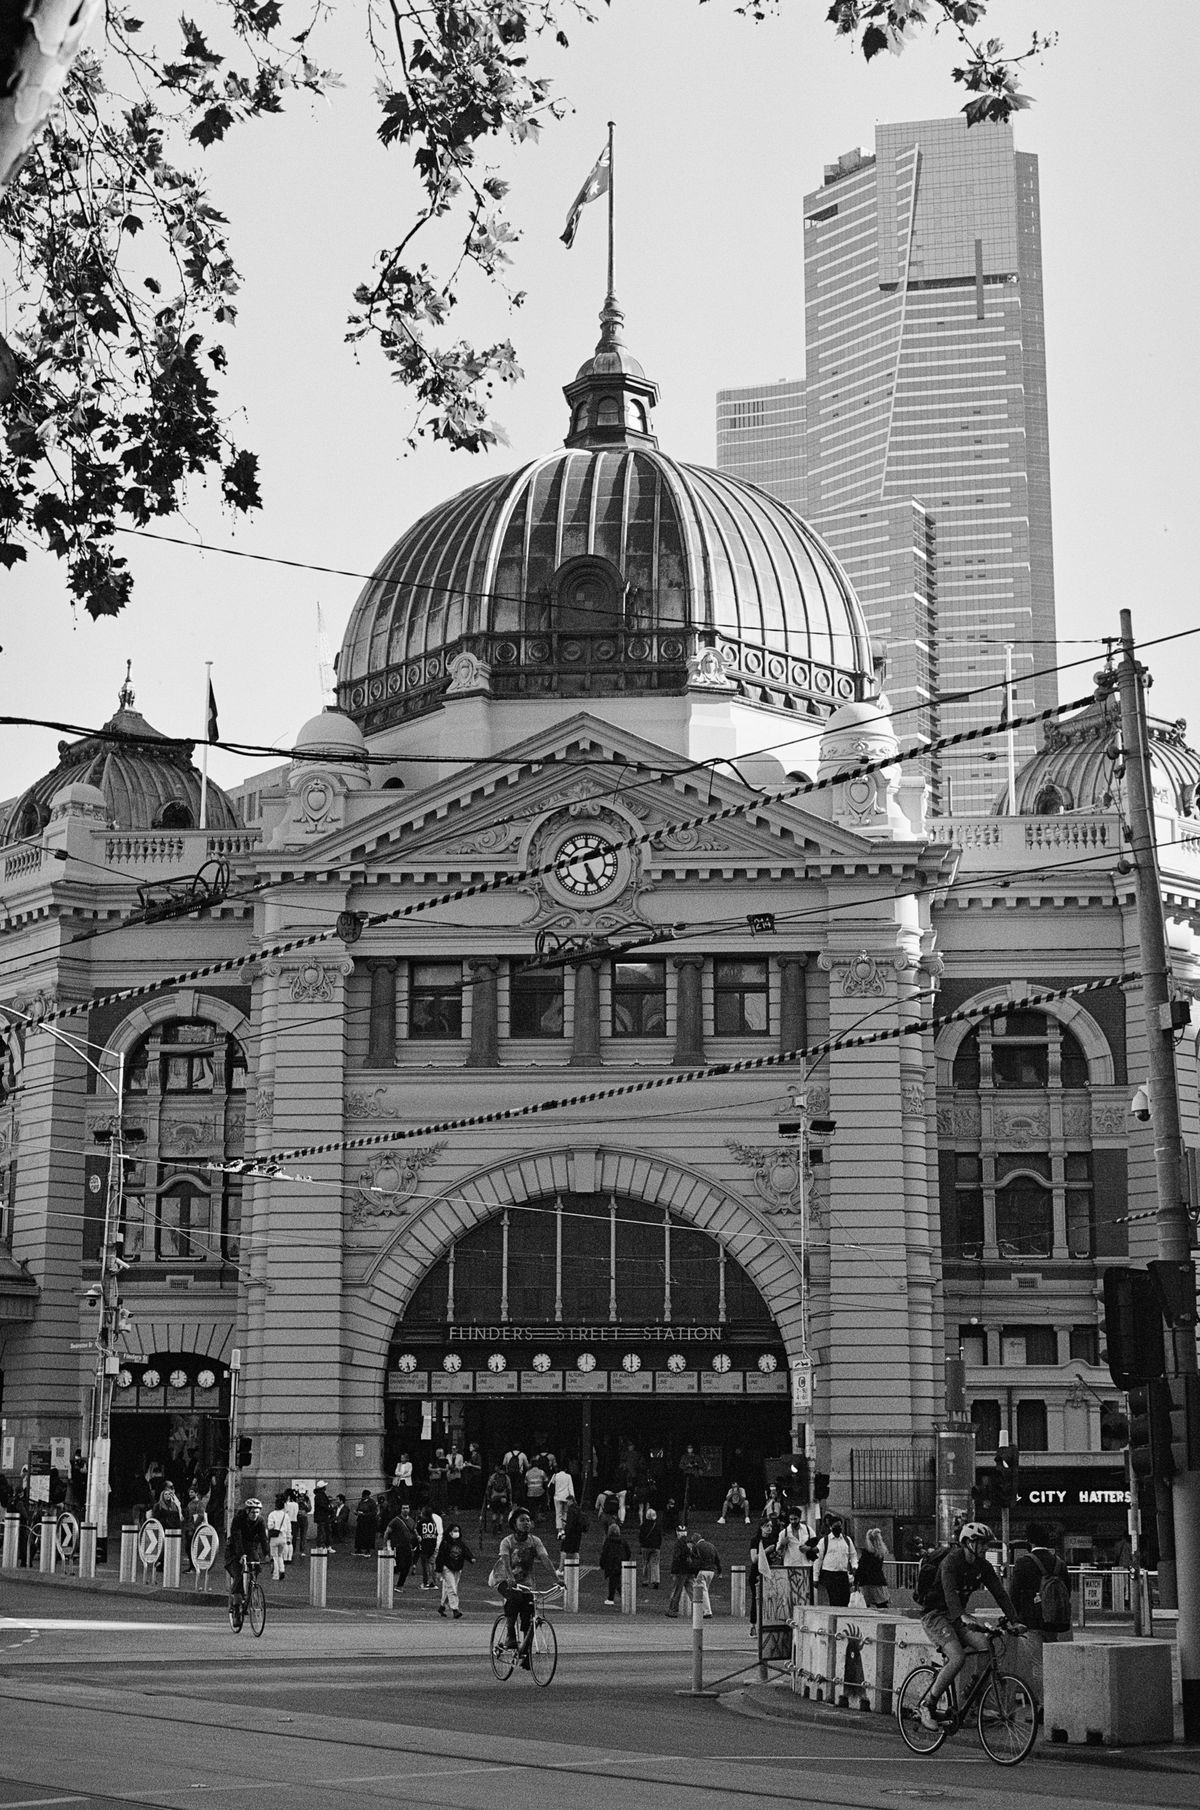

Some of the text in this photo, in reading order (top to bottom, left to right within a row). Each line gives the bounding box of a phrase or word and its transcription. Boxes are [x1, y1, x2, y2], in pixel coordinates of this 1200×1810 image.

[449, 1326, 721, 1341] FLINDERS STREET STATION
[1029, 1490, 1132, 1503] CITY HATTERS
[1088, 1589, 1098, 1598] FOR
